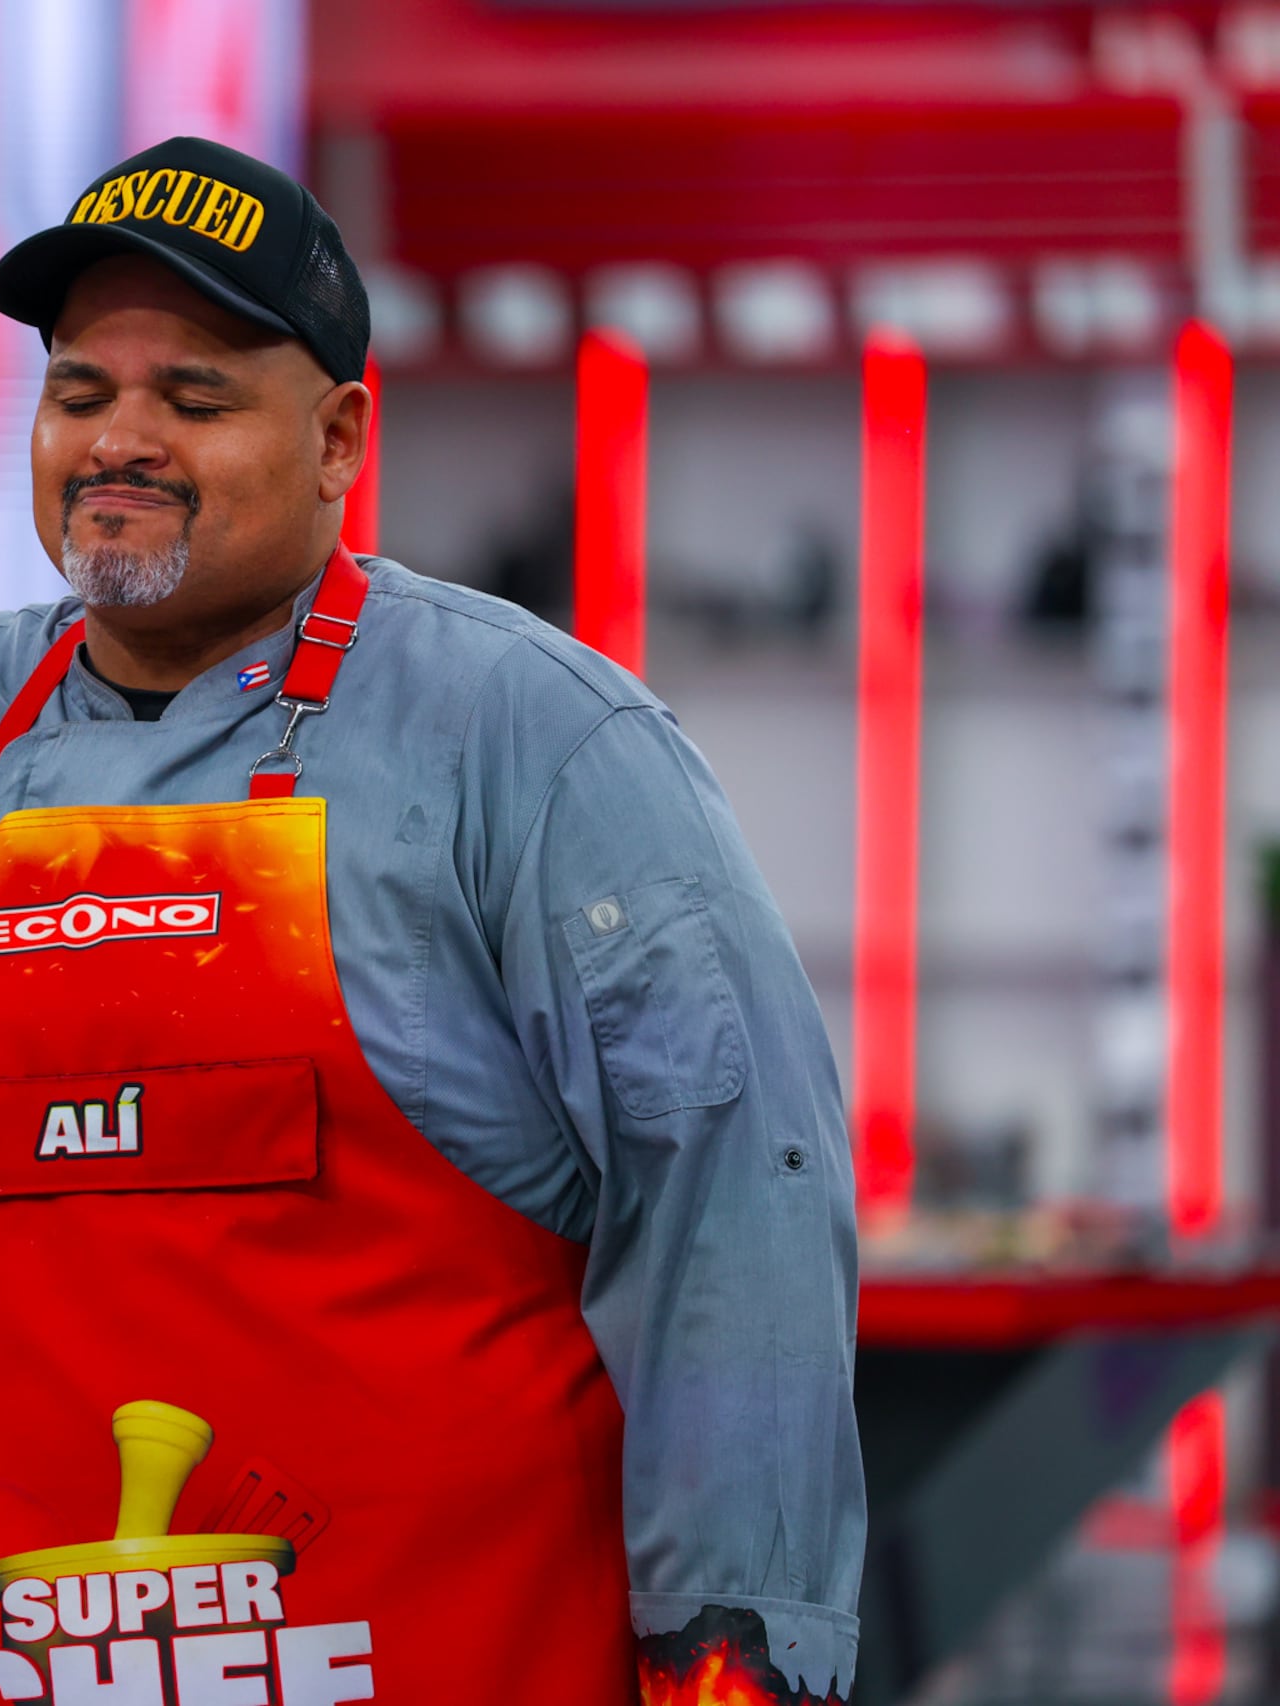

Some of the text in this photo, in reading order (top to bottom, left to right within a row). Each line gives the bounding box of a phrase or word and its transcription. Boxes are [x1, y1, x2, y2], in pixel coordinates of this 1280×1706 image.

[71, 168, 265, 253] RESCUED
[39, 1086, 140, 1156] ALÍ
[1, 1560, 285, 1642] SUPER
